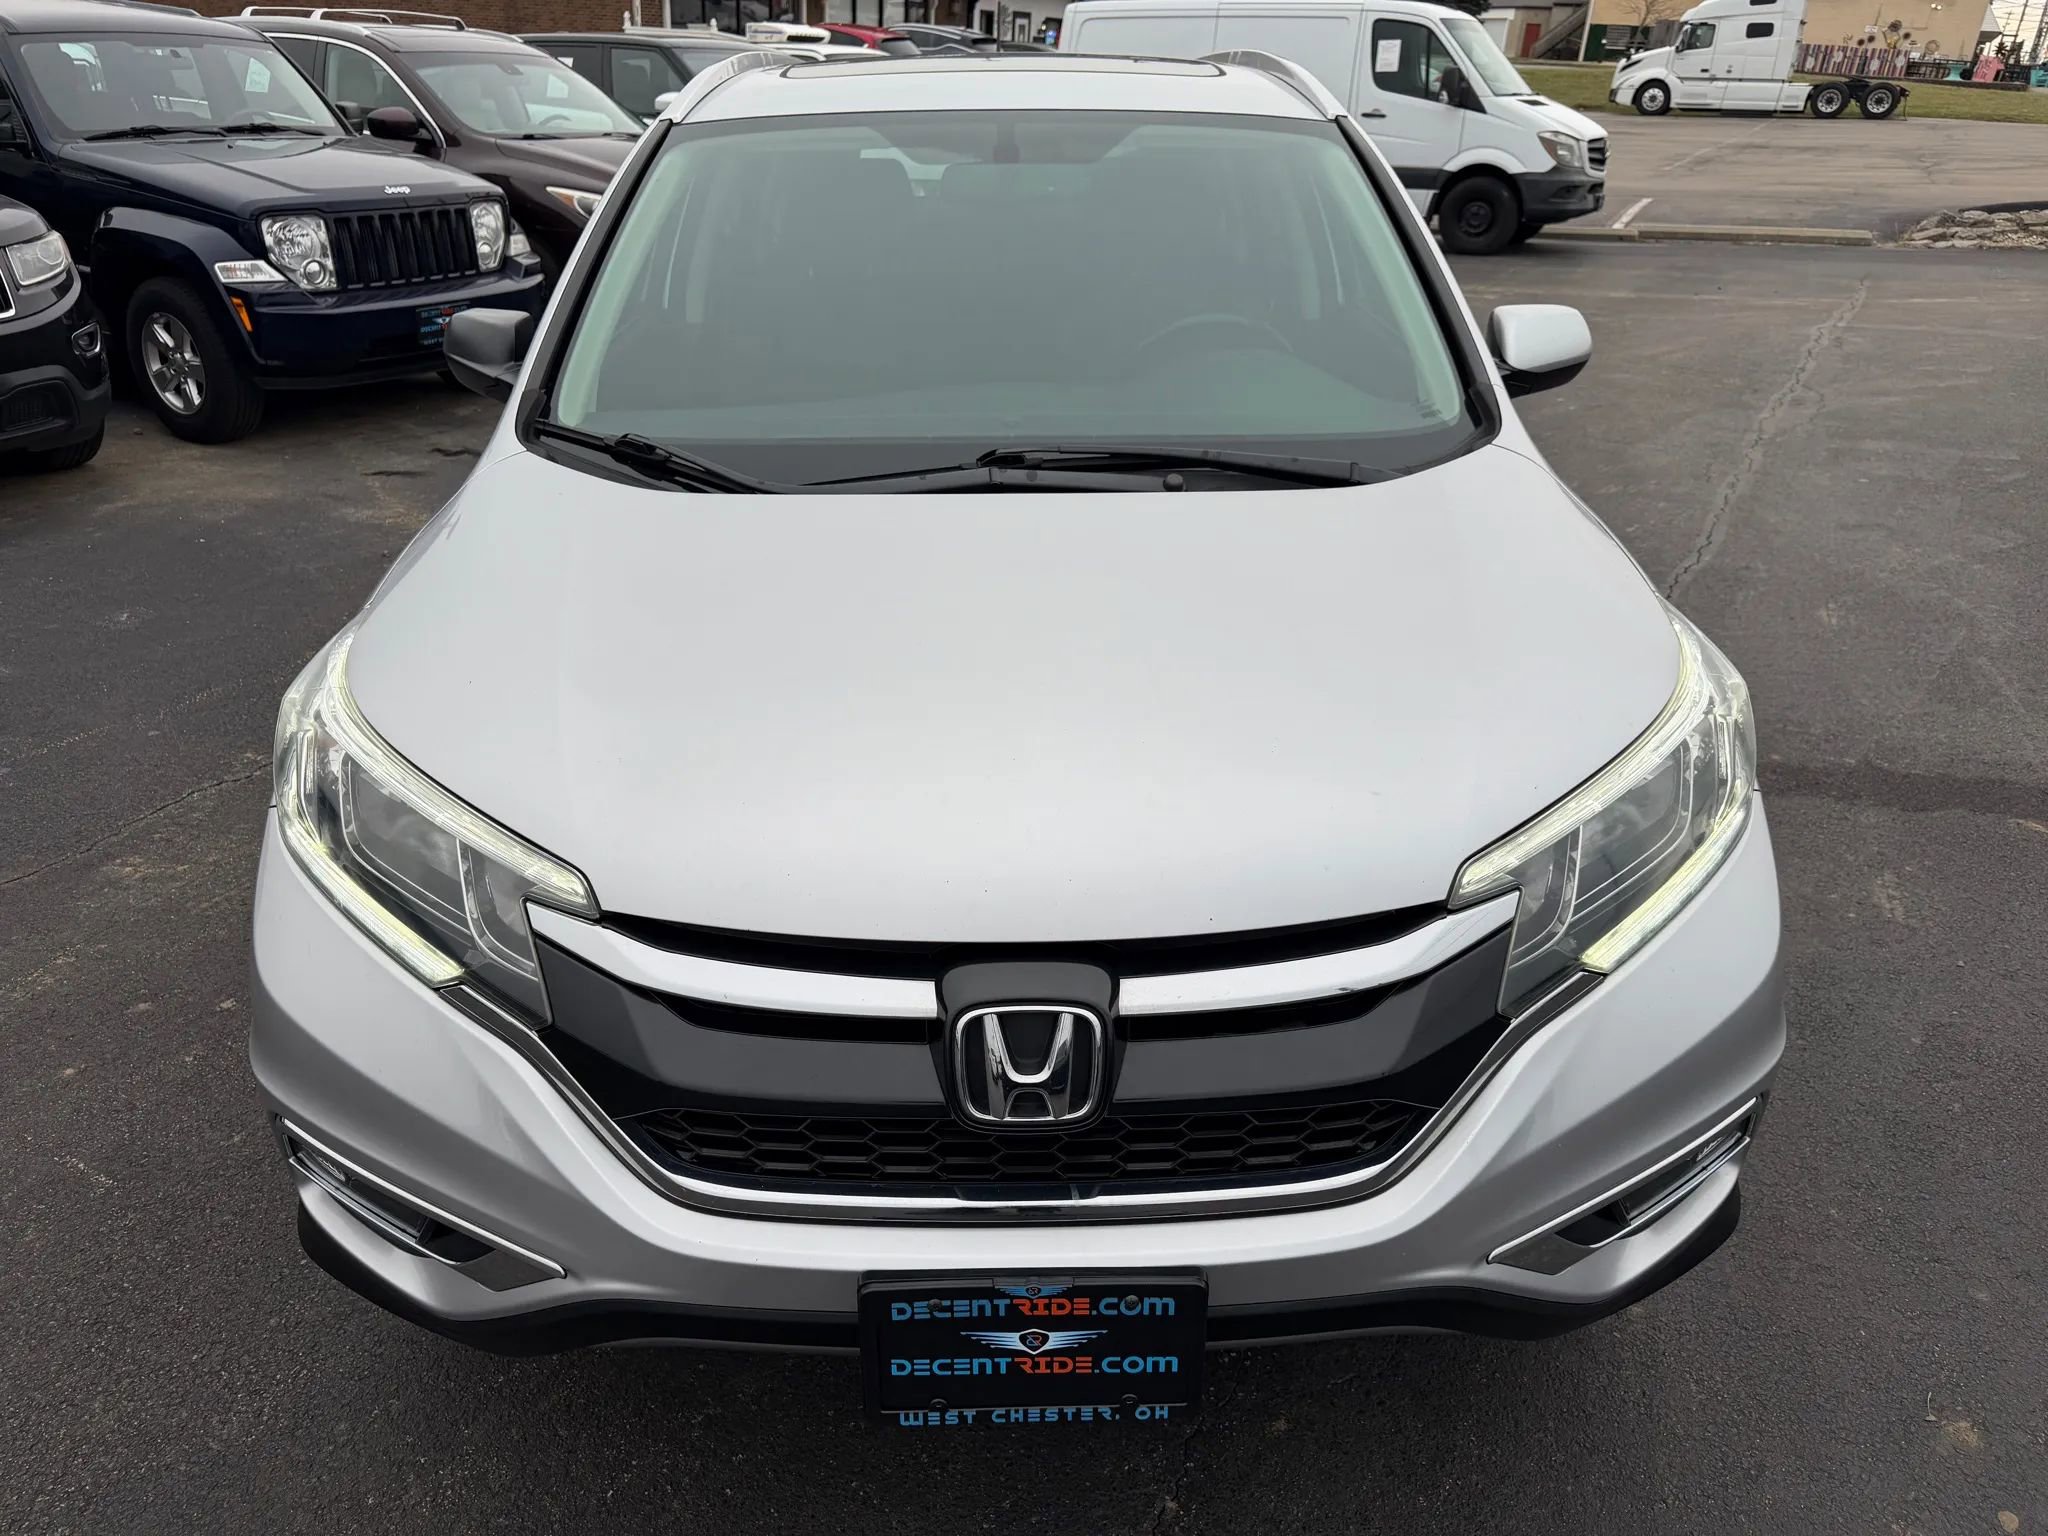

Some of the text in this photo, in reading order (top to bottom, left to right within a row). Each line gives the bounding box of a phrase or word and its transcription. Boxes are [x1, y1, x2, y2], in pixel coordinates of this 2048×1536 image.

[899, 1405, 1170, 1427] WEST CHESTER, OH
